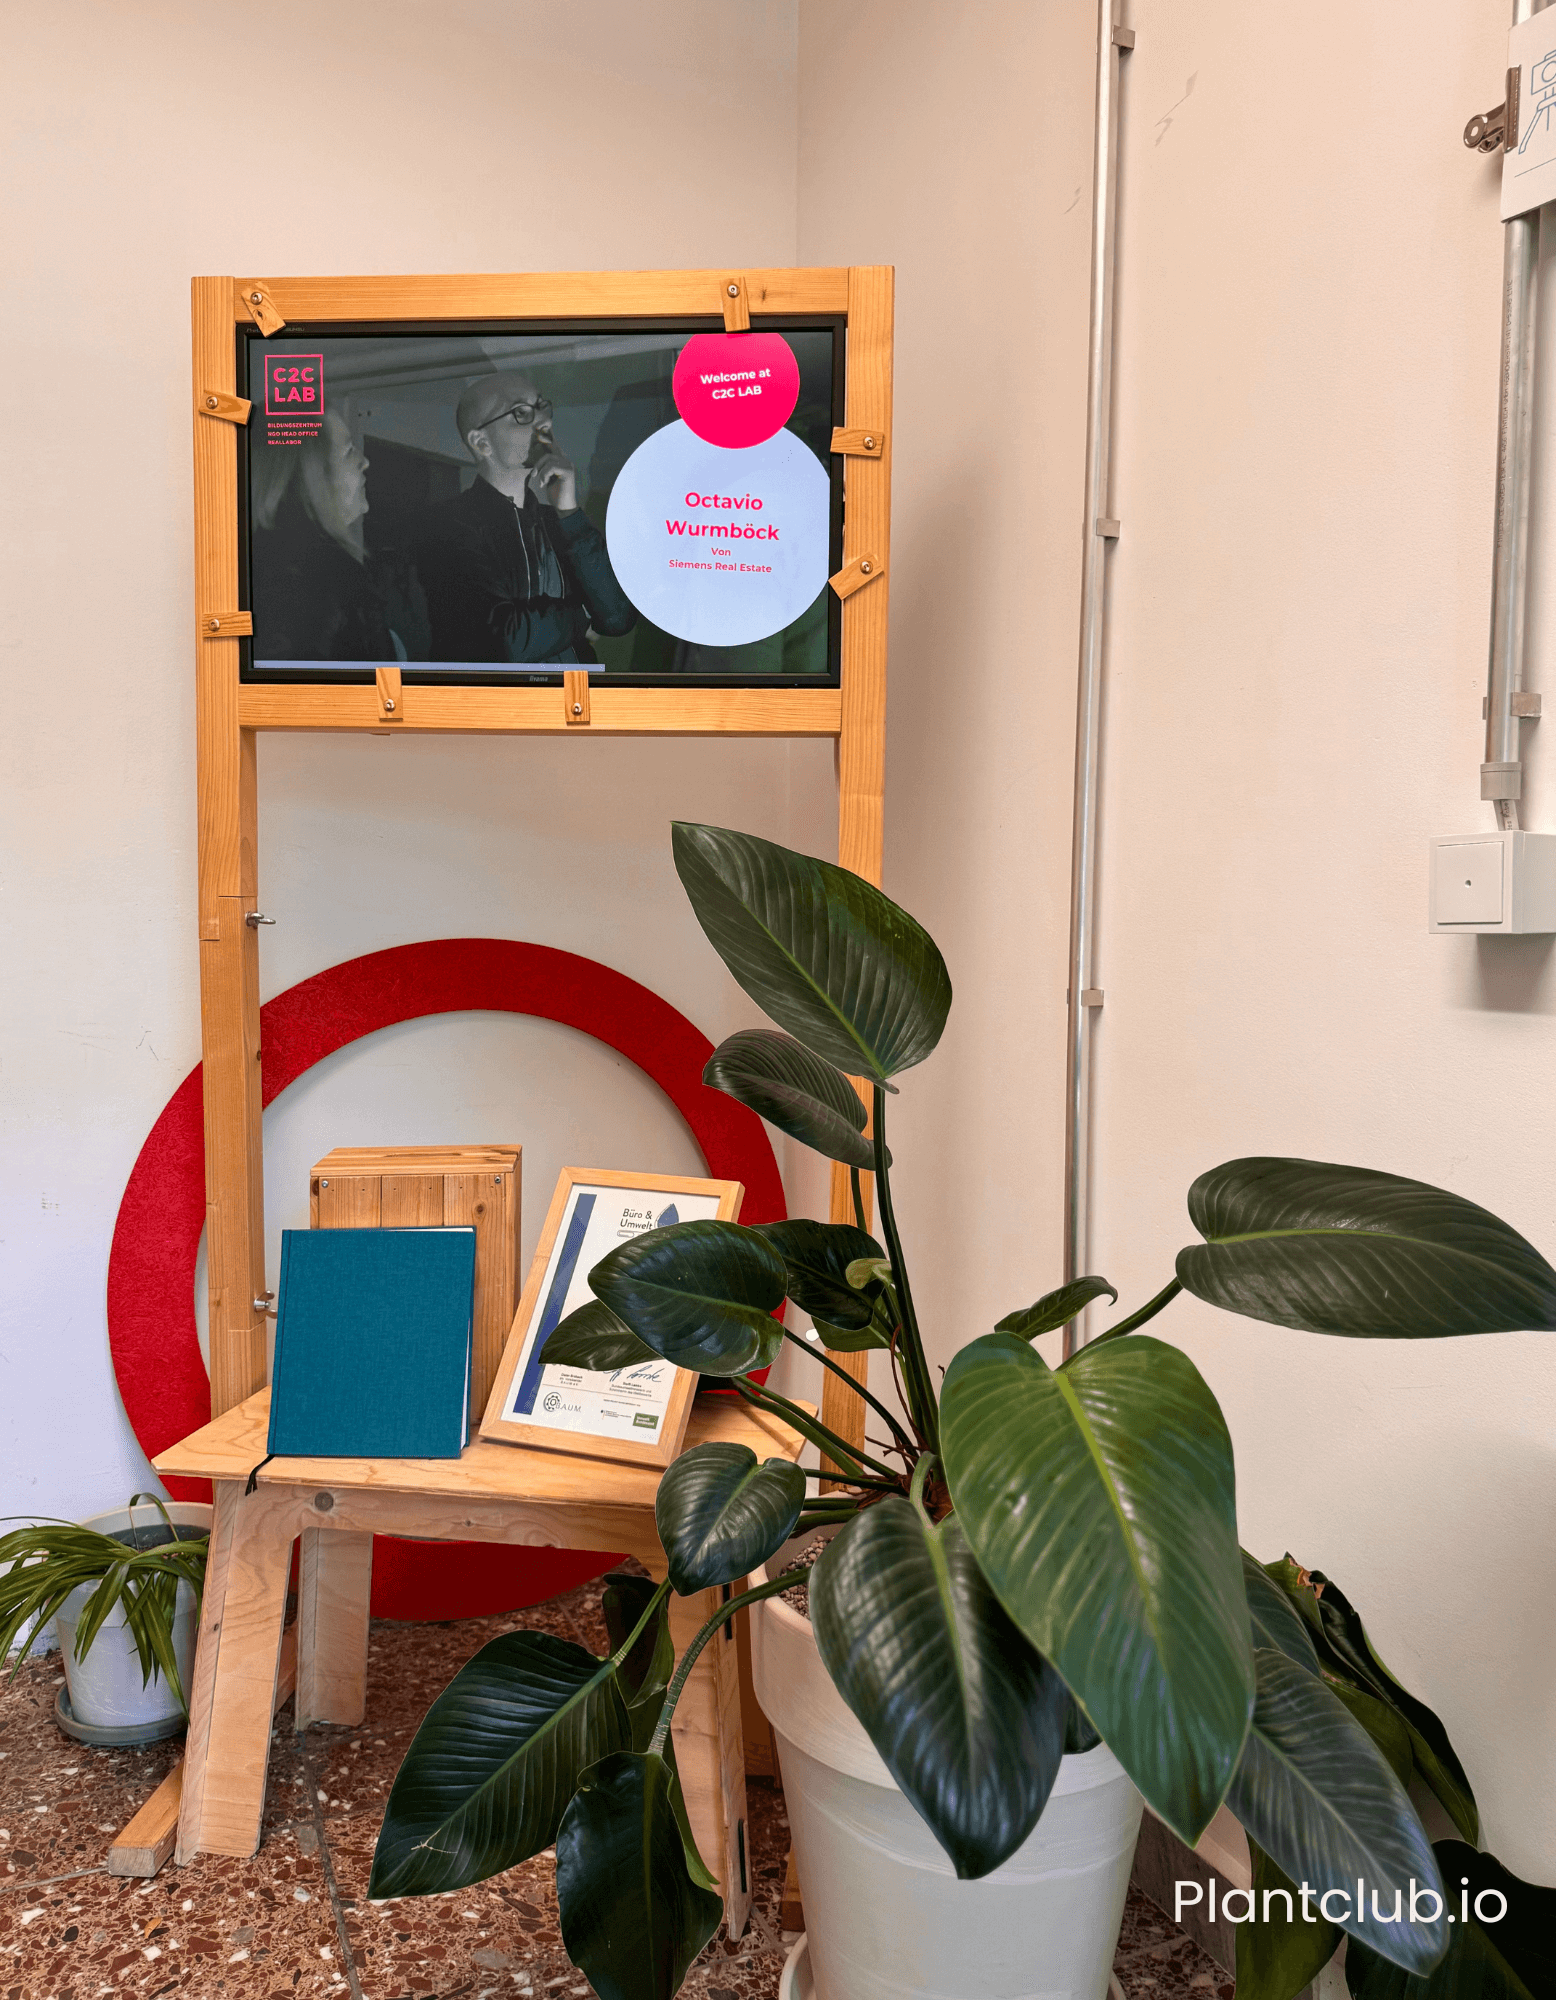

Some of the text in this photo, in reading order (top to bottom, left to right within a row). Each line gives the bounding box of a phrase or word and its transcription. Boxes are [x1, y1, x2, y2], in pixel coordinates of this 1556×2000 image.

[273, 367, 314, 383] C2C
[700, 368, 771, 384] Welcome at
[274, 386, 316, 402] LAB
[712, 385, 762, 399] C2C LAB
[685, 492, 763, 510] Octavio
[666, 520, 780, 540] Wurmböck
[711, 547, 731, 556] Von
[669, 559, 772, 573] Siemens Real Estate
[623, 1208, 653, 1220] Büro &
[620, 1219, 653, 1230] Umwelt
